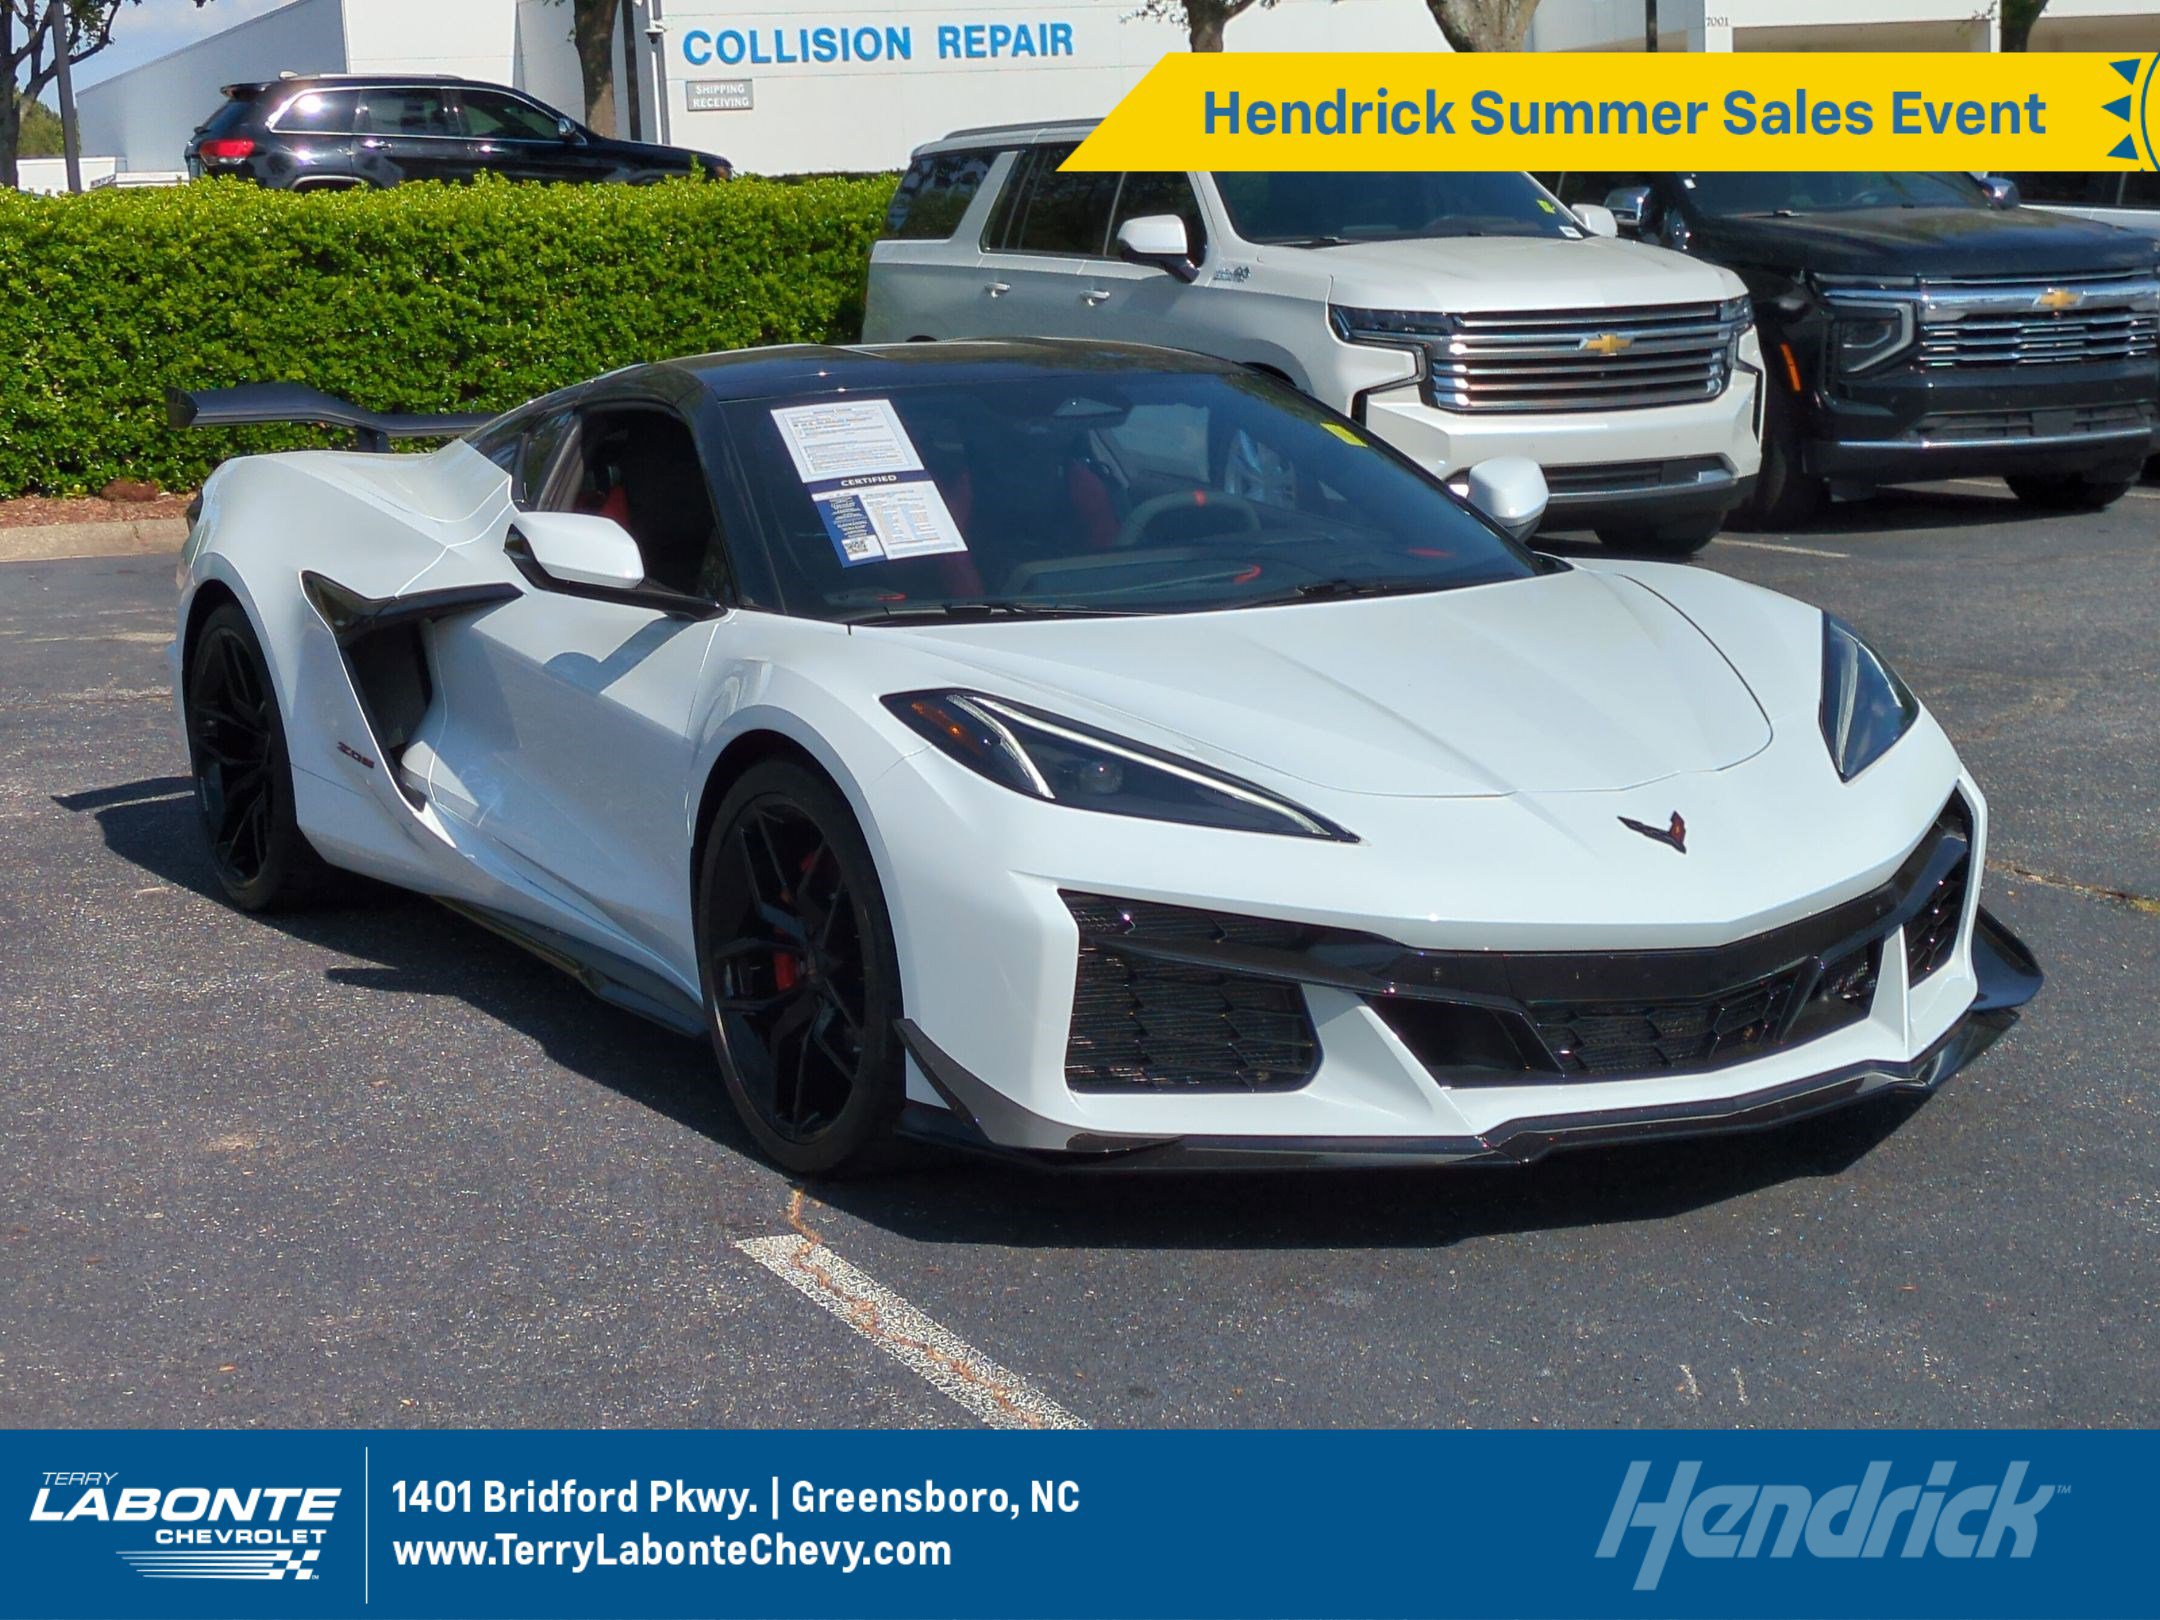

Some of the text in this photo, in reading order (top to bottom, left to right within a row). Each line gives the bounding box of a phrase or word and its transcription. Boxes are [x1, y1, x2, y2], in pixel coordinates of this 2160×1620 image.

[683, 22, 1073, 64] COLLISION REPAIR
[695, 84, 745, 95] SHIPPING
[693, 97, 749, 108] RECEIVING
[840, 474, 897, 487] CERTIFIED
